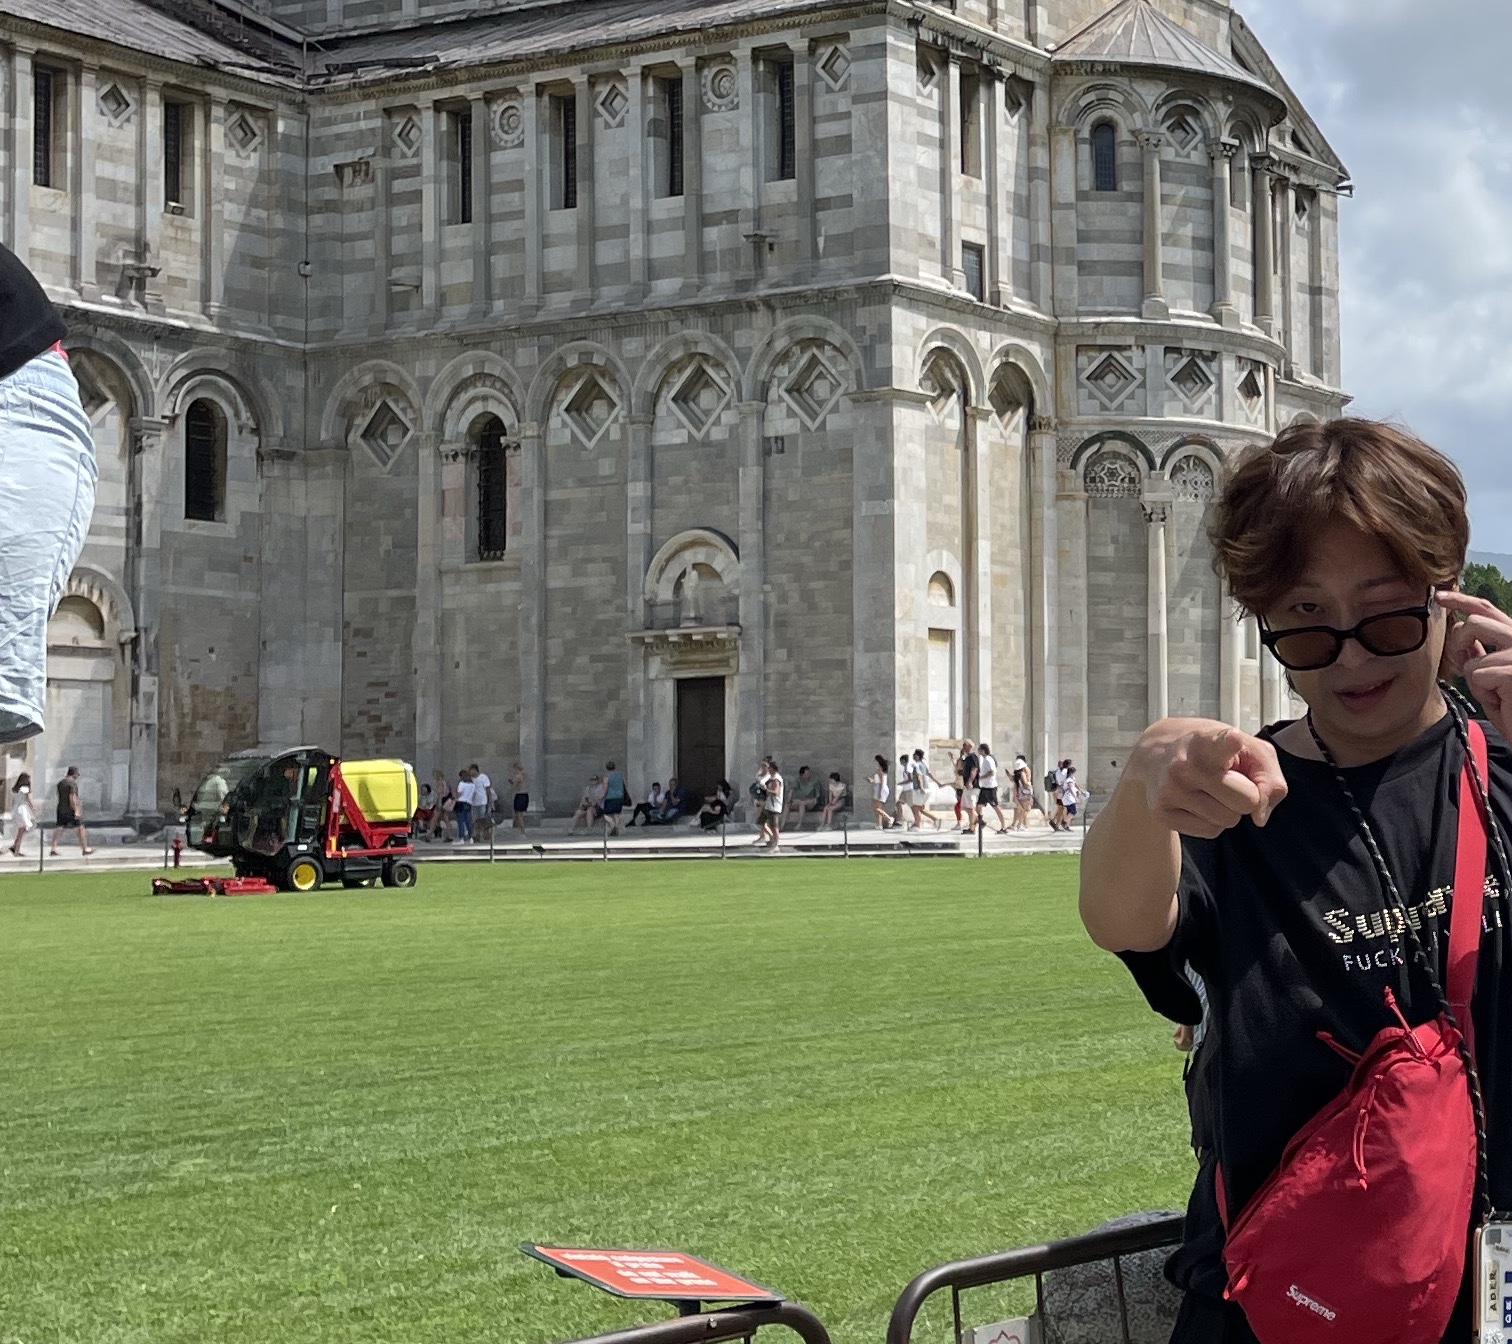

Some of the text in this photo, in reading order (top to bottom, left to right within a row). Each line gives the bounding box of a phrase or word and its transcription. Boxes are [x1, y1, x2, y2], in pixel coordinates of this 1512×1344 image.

[1323, 874, 1500, 944] Supre
[1342, 947, 1404, 972] FUCK
[1285, 1284, 1337, 1321] Supreme
[1488, 1268, 1498, 1312] ADER
